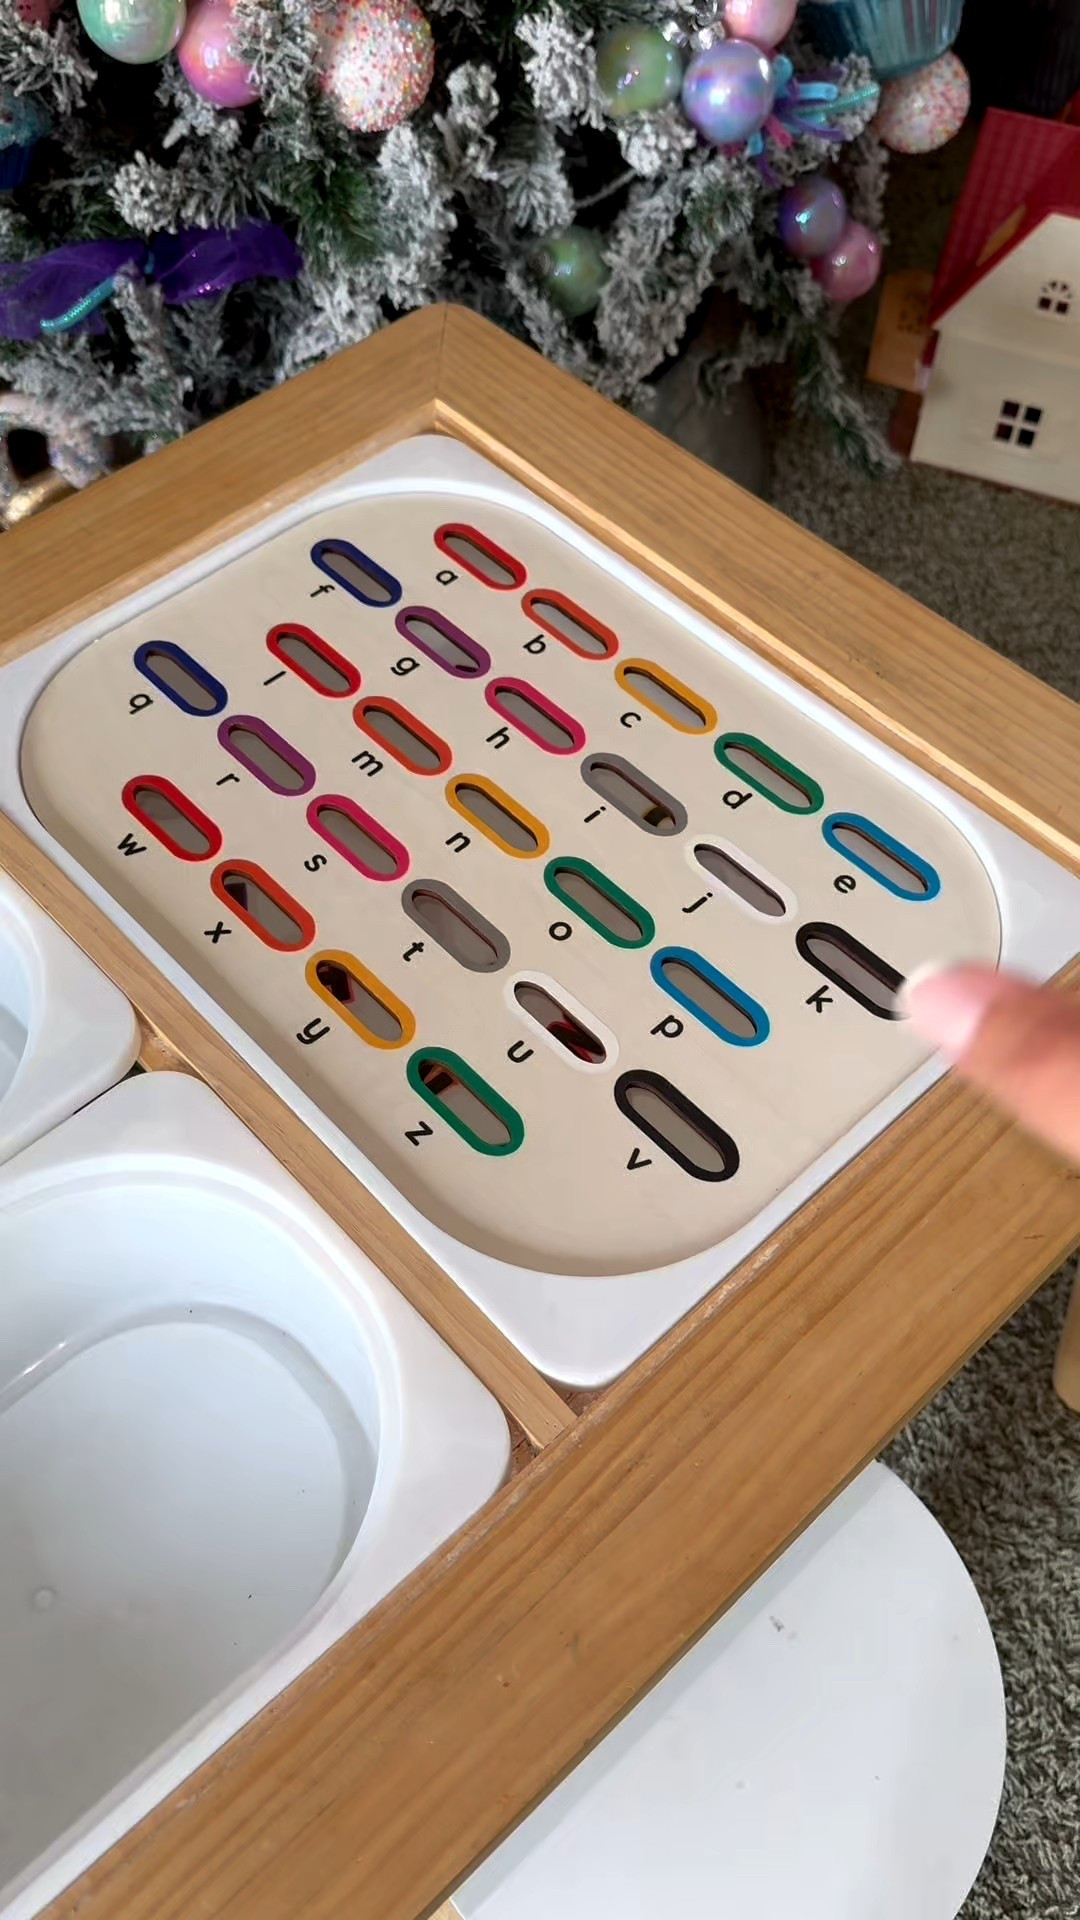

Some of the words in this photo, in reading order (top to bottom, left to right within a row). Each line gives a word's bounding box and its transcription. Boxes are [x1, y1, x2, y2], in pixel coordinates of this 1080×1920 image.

[435, 569, 459, 587] a
[309, 584, 336, 599] f
[522, 633, 547, 655] b
[389, 656, 421, 677] g
[262, 670, 287, 687] l
[128, 693, 155, 716] q
[619, 711, 642, 729] c
[485, 726, 511, 750] h
[350, 750, 384, 778] m
[215, 772, 241, 787] r
[721, 789, 754, 810] d
[583, 805, 607, 824] i
[116, 832, 148, 857] w
[444, 831, 472, 854] n
[303, 853, 328, 873] s
[832, 874, 857, 895] e
[681, 891, 714, 914] j
[203, 920, 233, 945] x
[548, 921, 573, 942] o
[402, 941, 425, 963] t
[805, 984, 834, 1014] k
[295, 1017, 331, 1046] y
[649, 1014, 685, 1039] p
[506, 1039, 535, 1064] u
[403, 1120, 434, 1147] z
[626, 1147, 653, 1171] v
